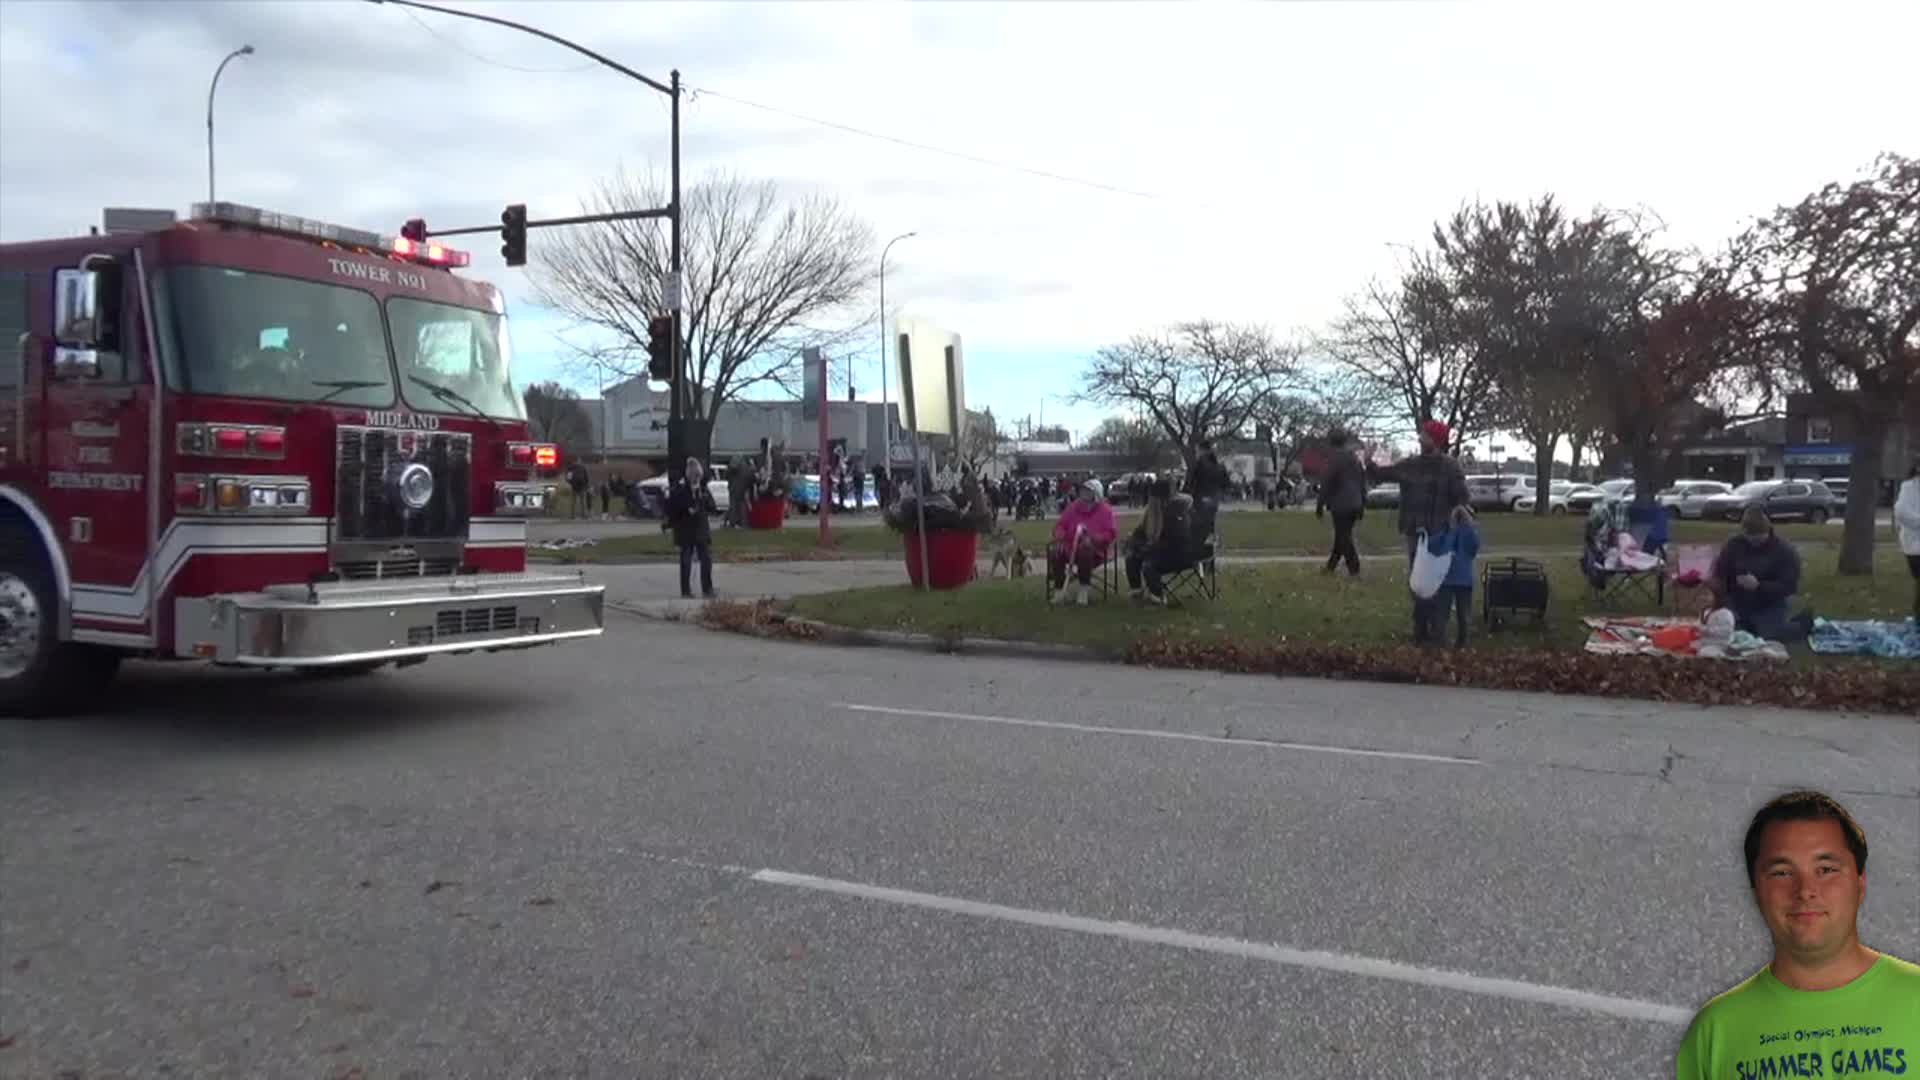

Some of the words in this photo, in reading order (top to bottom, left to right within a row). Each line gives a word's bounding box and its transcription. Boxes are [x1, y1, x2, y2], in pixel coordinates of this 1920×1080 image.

[328, 258, 391, 283] TOWER
[365, 410, 440, 430] MIDLAND
[1759, 1031, 1790, 1045] Special
[1839, 1024, 1882, 1037] Michigan
[1736, 1052, 1823, 1080] SUMMER
[1831, 1047, 1907, 1076] GAMES
